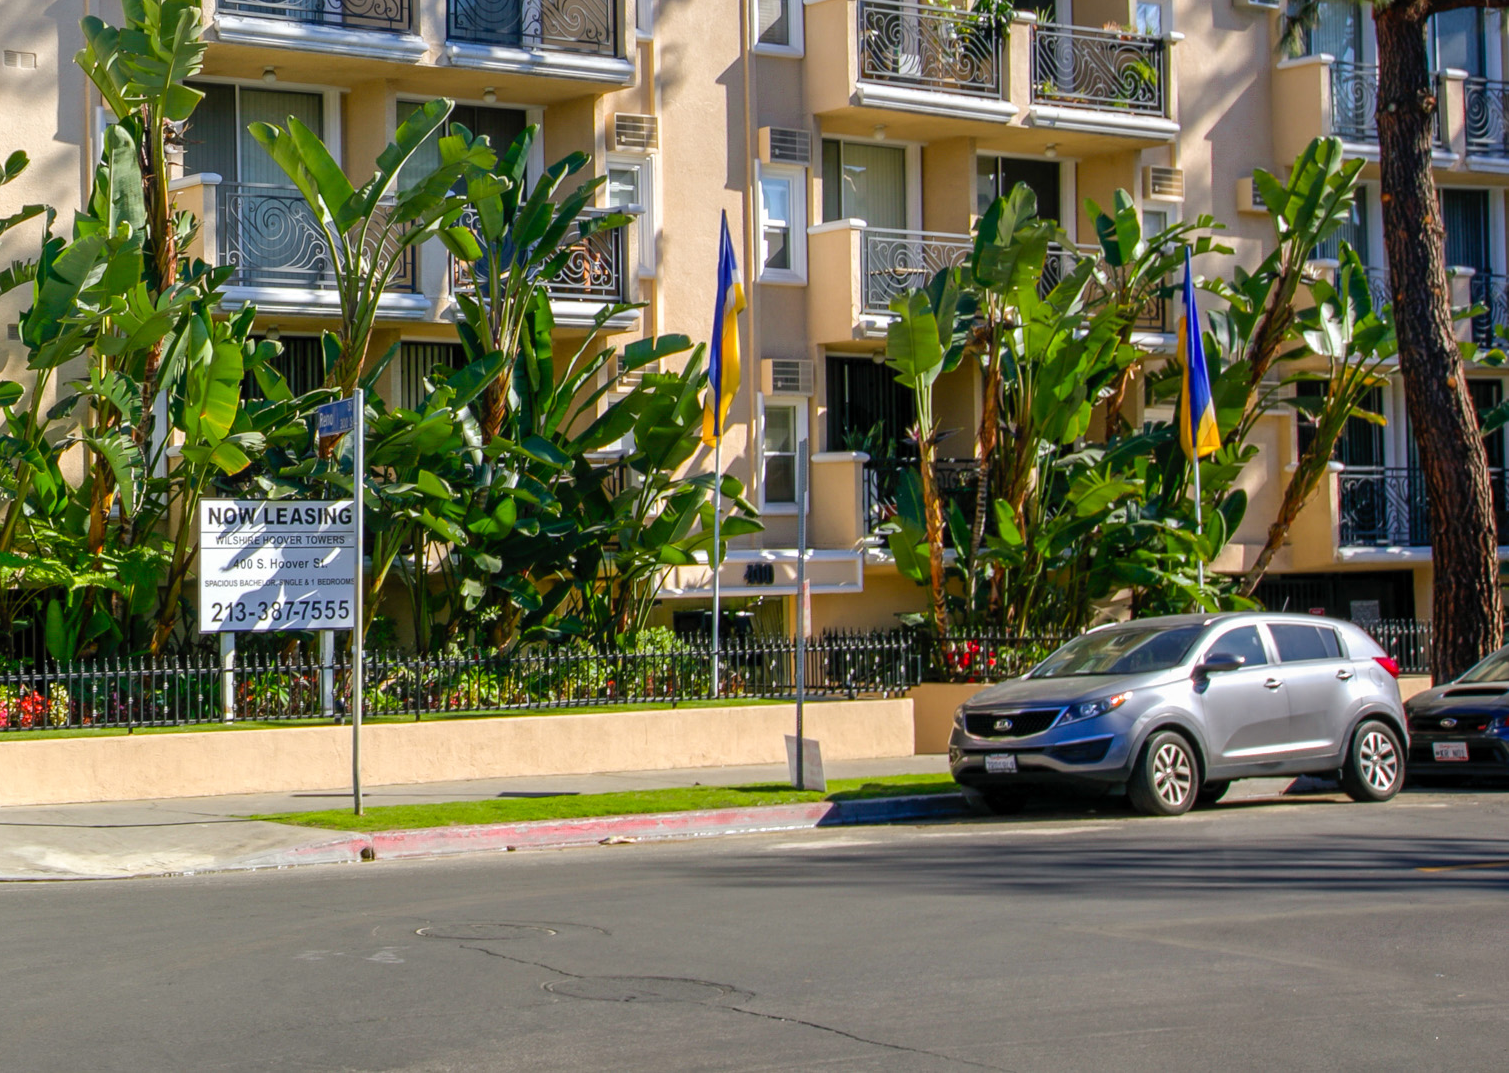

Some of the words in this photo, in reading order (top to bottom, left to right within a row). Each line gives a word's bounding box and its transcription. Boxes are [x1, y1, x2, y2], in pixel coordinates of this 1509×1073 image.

[319, 413, 334, 428] Reno
[208, 507, 255, 525] NOW
[264, 507, 352, 525] LEASING
[216, 536, 260, 545] WILSHIRE
[263, 536, 302, 545] HOOVER
[306, 535, 345, 544] TOWERS
[233, 559, 253, 569] 400
[257, 558, 267, 569] S.
[270, 558, 309, 569] Hoover
[313, 558, 328, 568] St.
[205, 580, 238, 588] SPACIOUS
[279, 579, 303, 587] SINGLE
[211, 600, 350, 623] 213-387-7555
